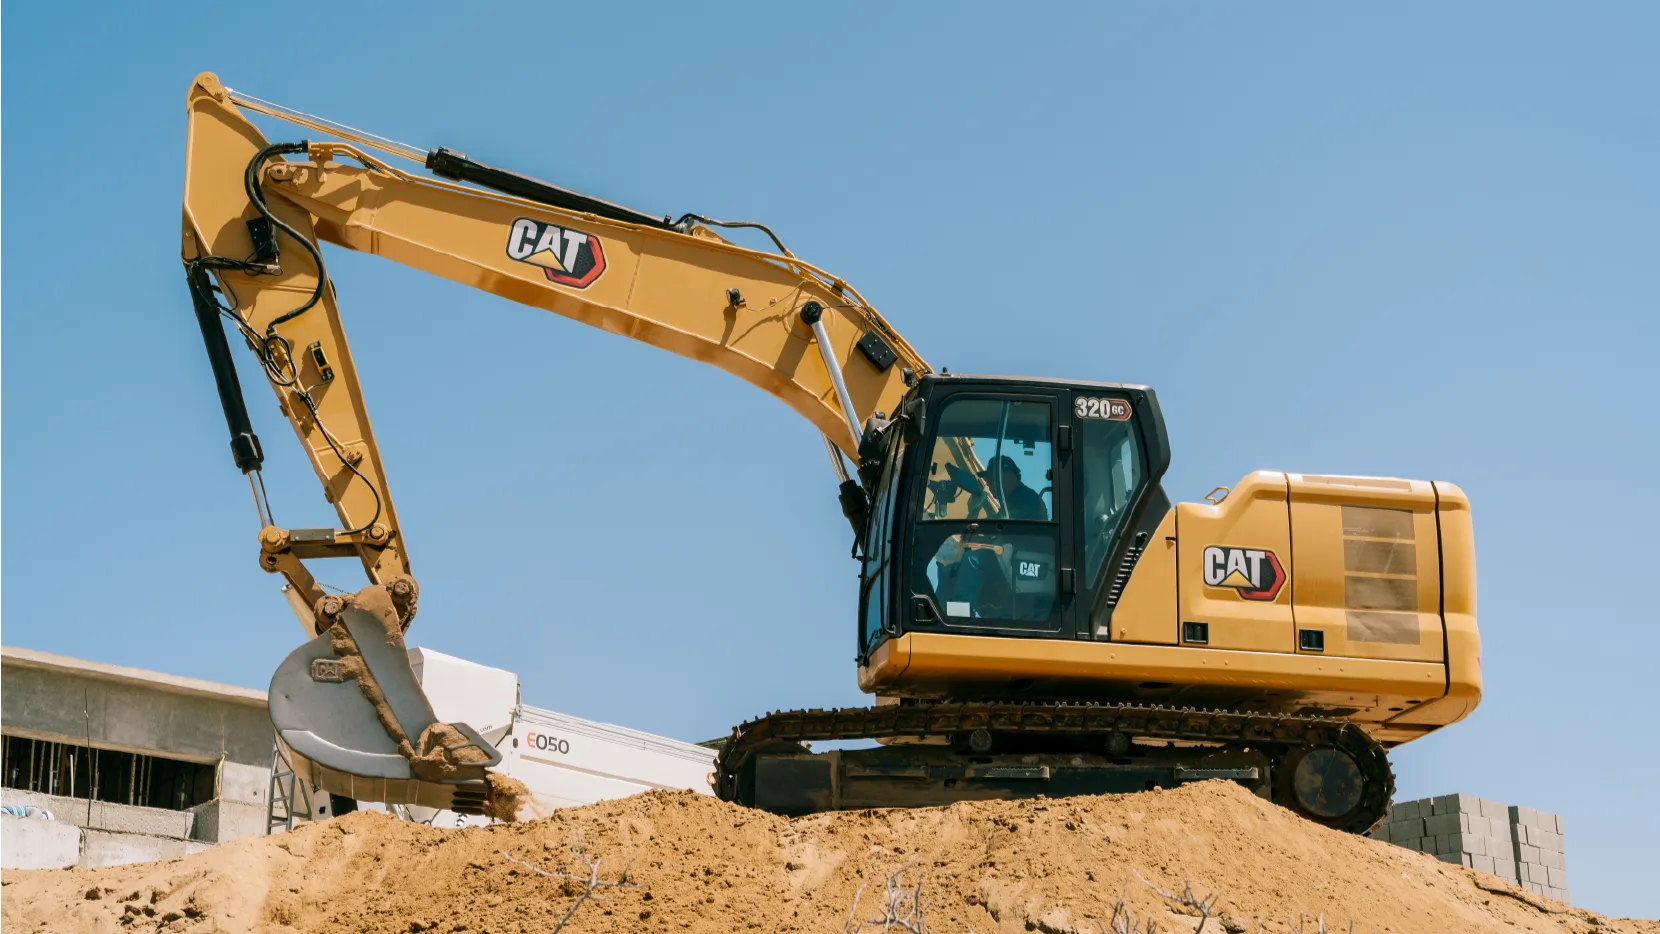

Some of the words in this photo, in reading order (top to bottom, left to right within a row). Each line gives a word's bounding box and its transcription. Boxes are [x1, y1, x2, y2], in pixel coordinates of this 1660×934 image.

[507, 219, 588, 274] CAT
[1076, 398, 1111, 419] 320
[1111, 405, 1125, 415] GC
[1019, 561, 1040, 577] CAT
[1204, 546, 1266, 588] CAT
[477, 725, 493, 733] .com
